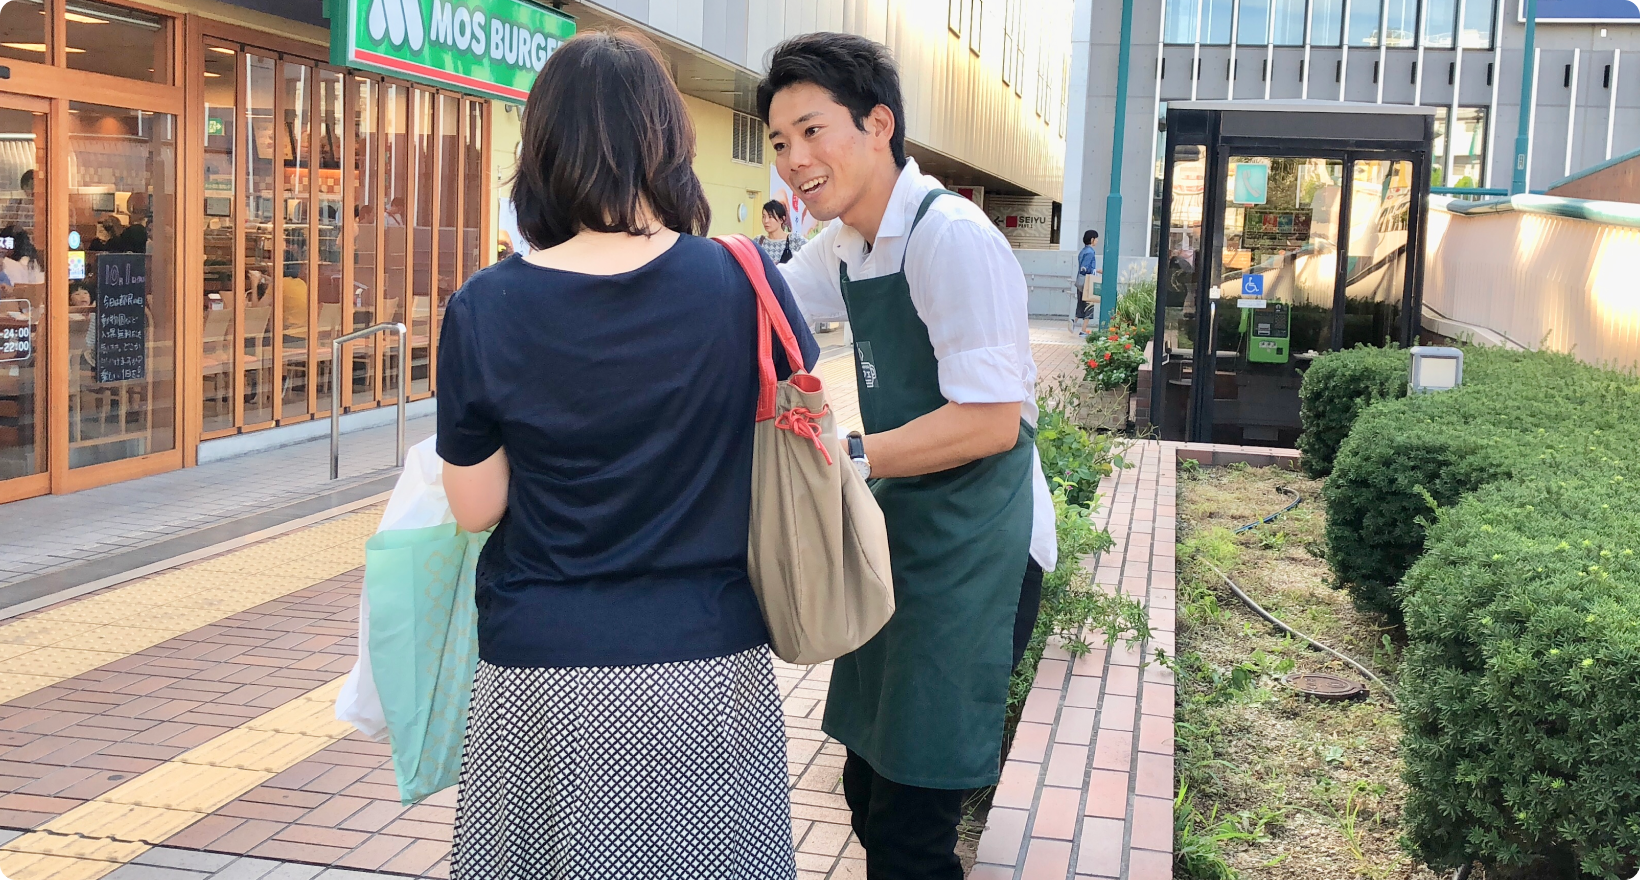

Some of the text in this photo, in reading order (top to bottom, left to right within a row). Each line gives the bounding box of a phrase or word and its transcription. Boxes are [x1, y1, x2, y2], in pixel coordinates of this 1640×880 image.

[430, 0, 564, 73] MOS BURGE
[1018, 216, 1046, 224] SEIYU
